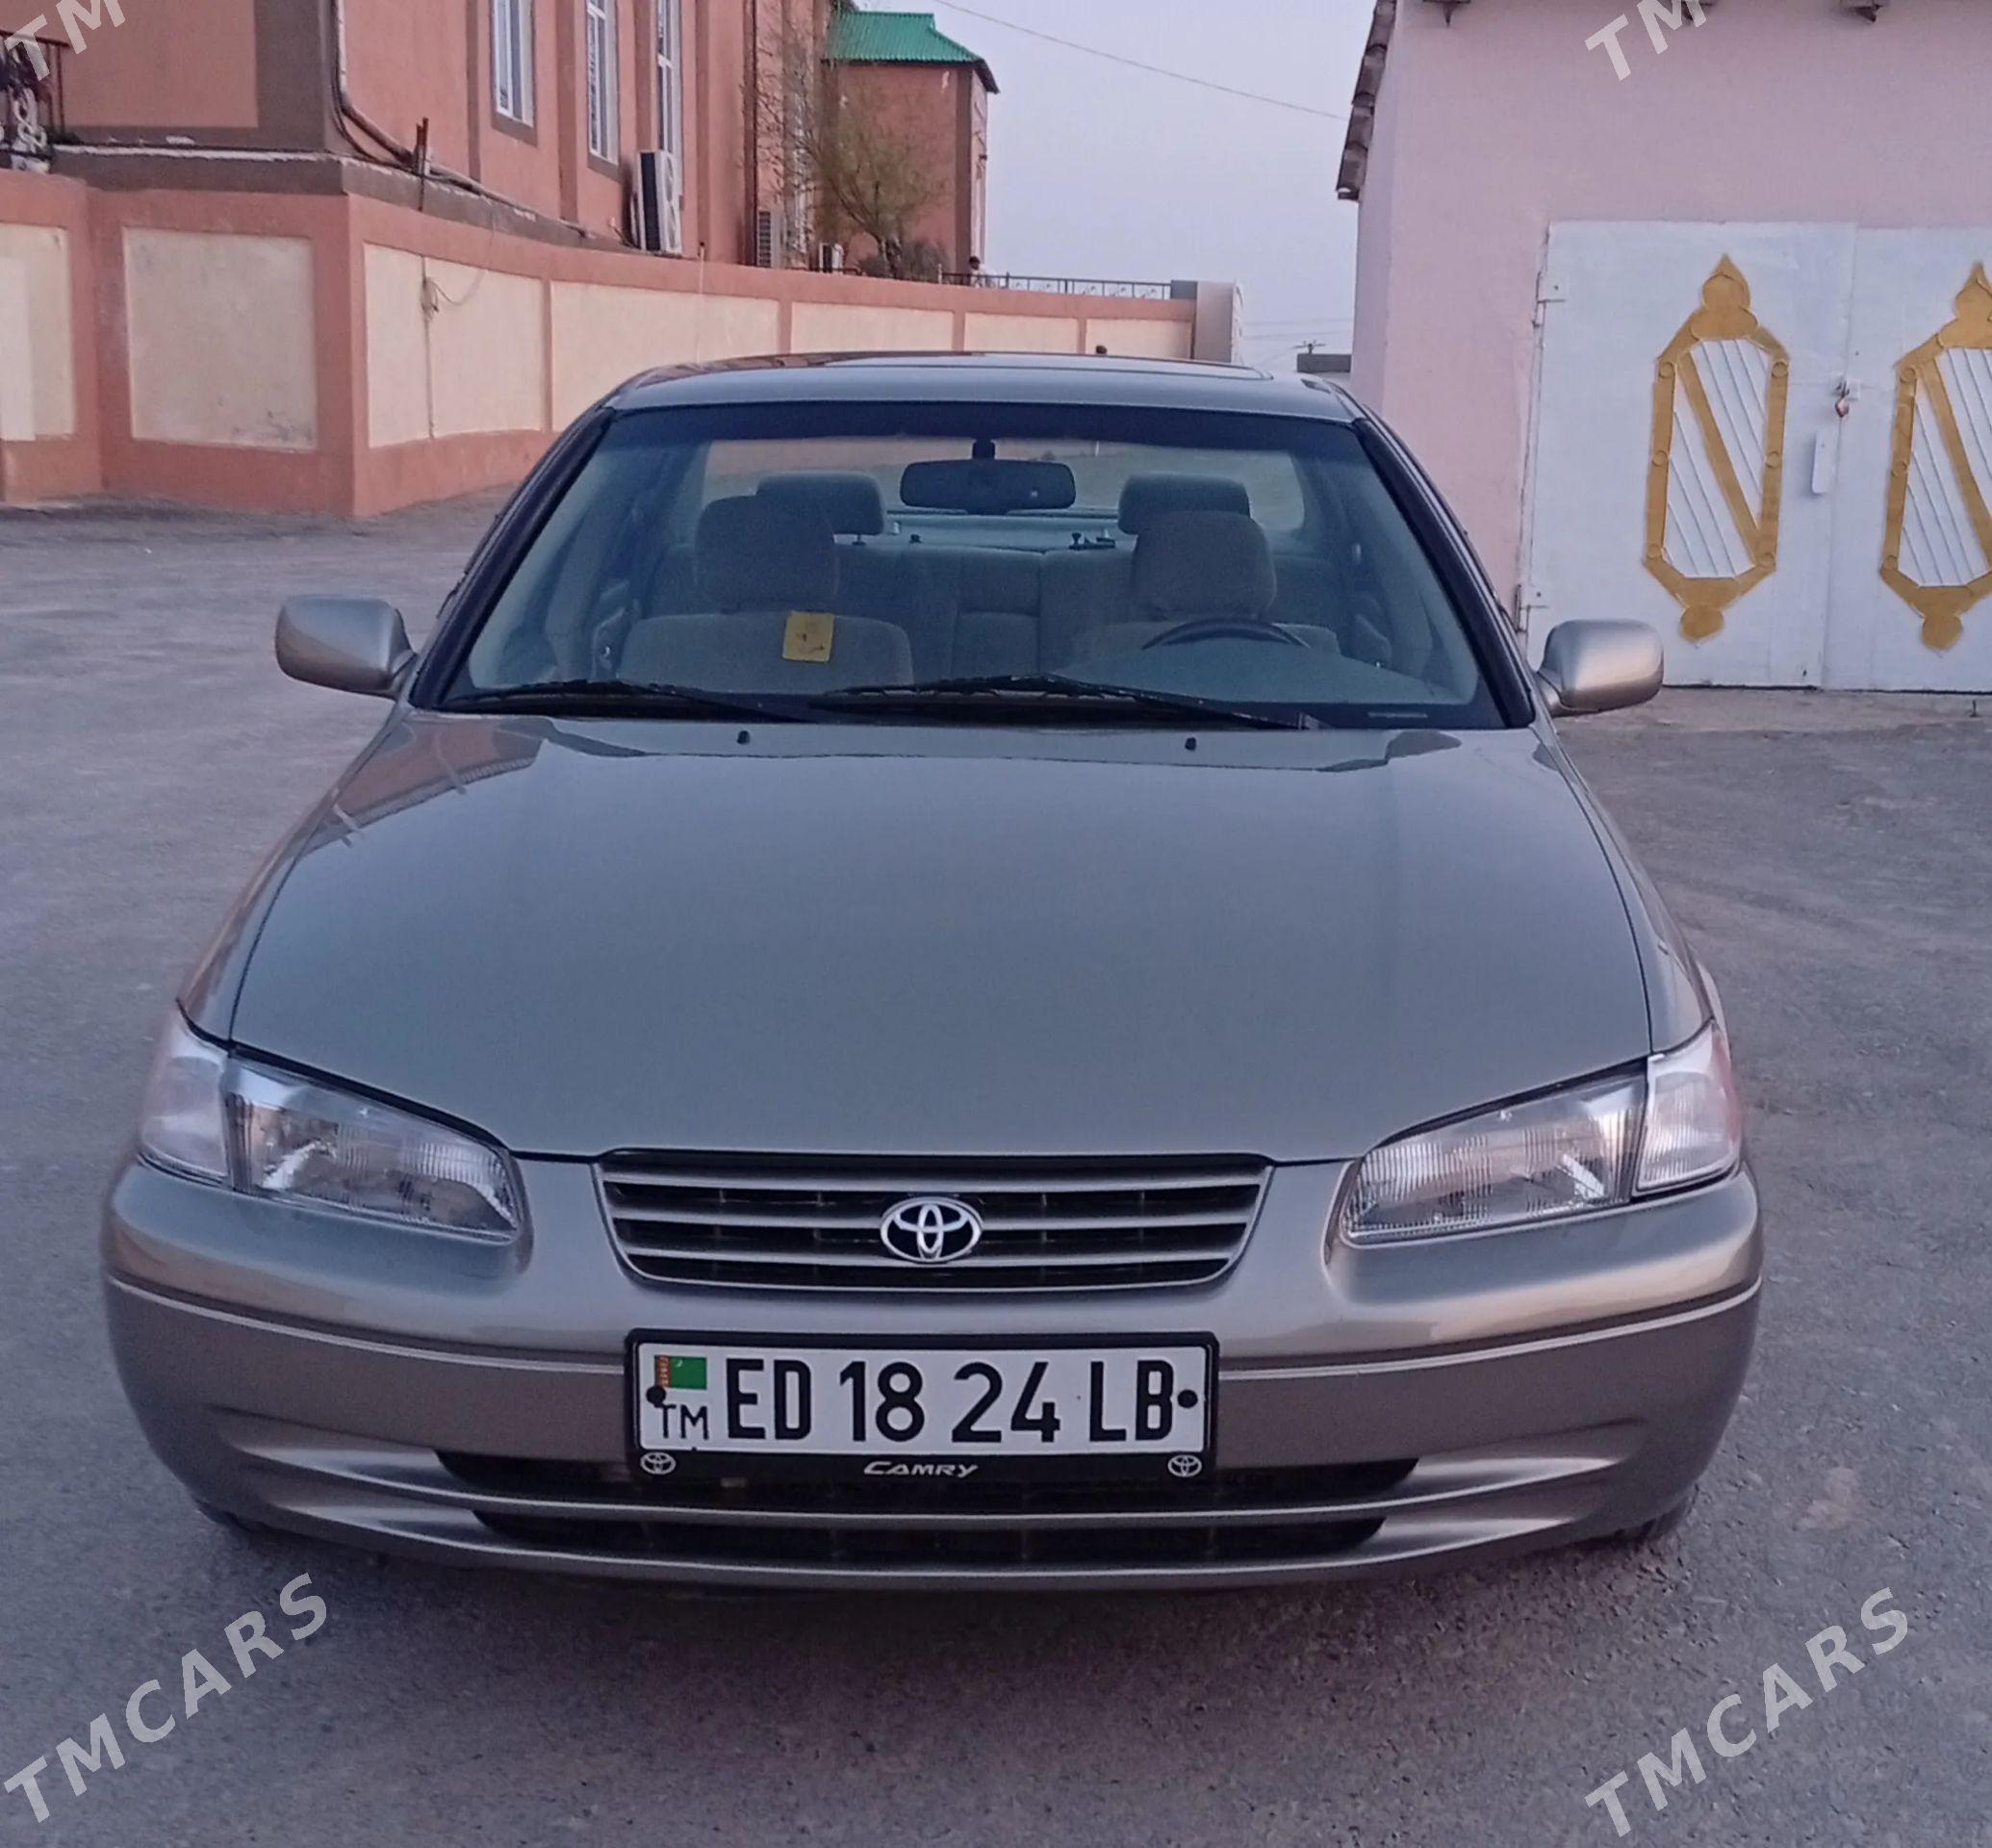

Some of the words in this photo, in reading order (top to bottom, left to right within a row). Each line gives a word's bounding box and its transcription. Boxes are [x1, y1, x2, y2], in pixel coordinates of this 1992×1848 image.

[727, 1358, 811, 1440] ED
[839, 1361, 925, 1443] 18
[951, 1361, 1061, 1443] 24
[1089, 1360, 1173, 1443] LB
[653, 1403, 709, 1440] TM
[863, 1460, 979, 1478] CAMRY
